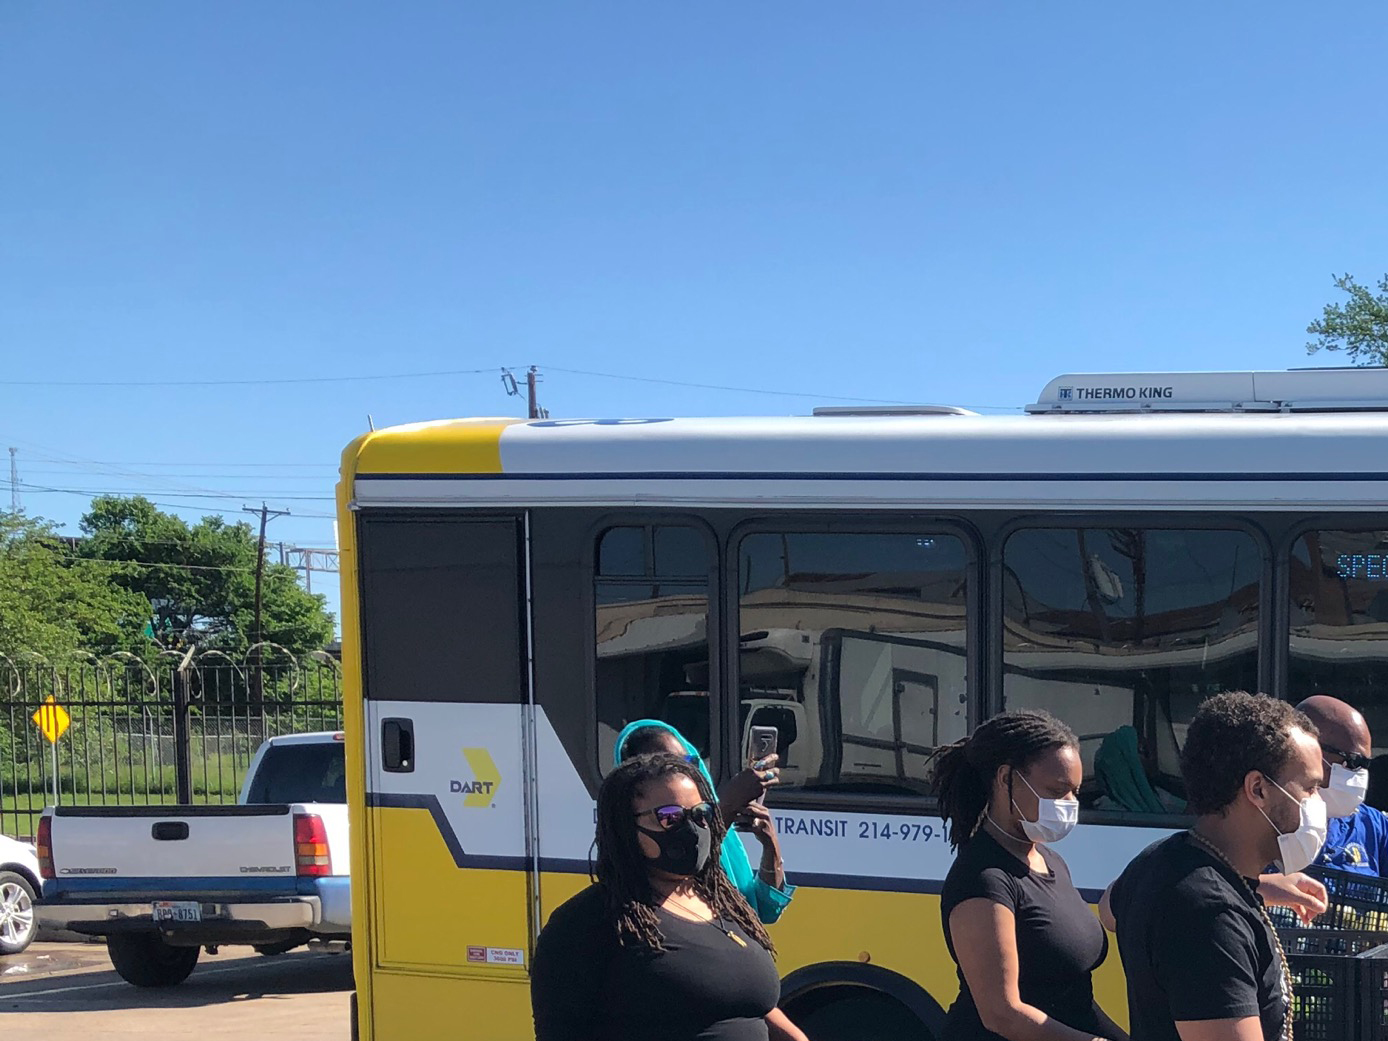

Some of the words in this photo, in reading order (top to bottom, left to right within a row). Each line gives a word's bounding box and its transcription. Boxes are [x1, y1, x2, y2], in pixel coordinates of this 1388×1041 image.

[1076, 388, 1136, 399] THERMO
[1139, 387, 1173, 398] KING
[450, 780, 493, 794] DART
[775, 817, 848, 837] TRANSIT
[859, 821, 948, 843] 214-979-1
